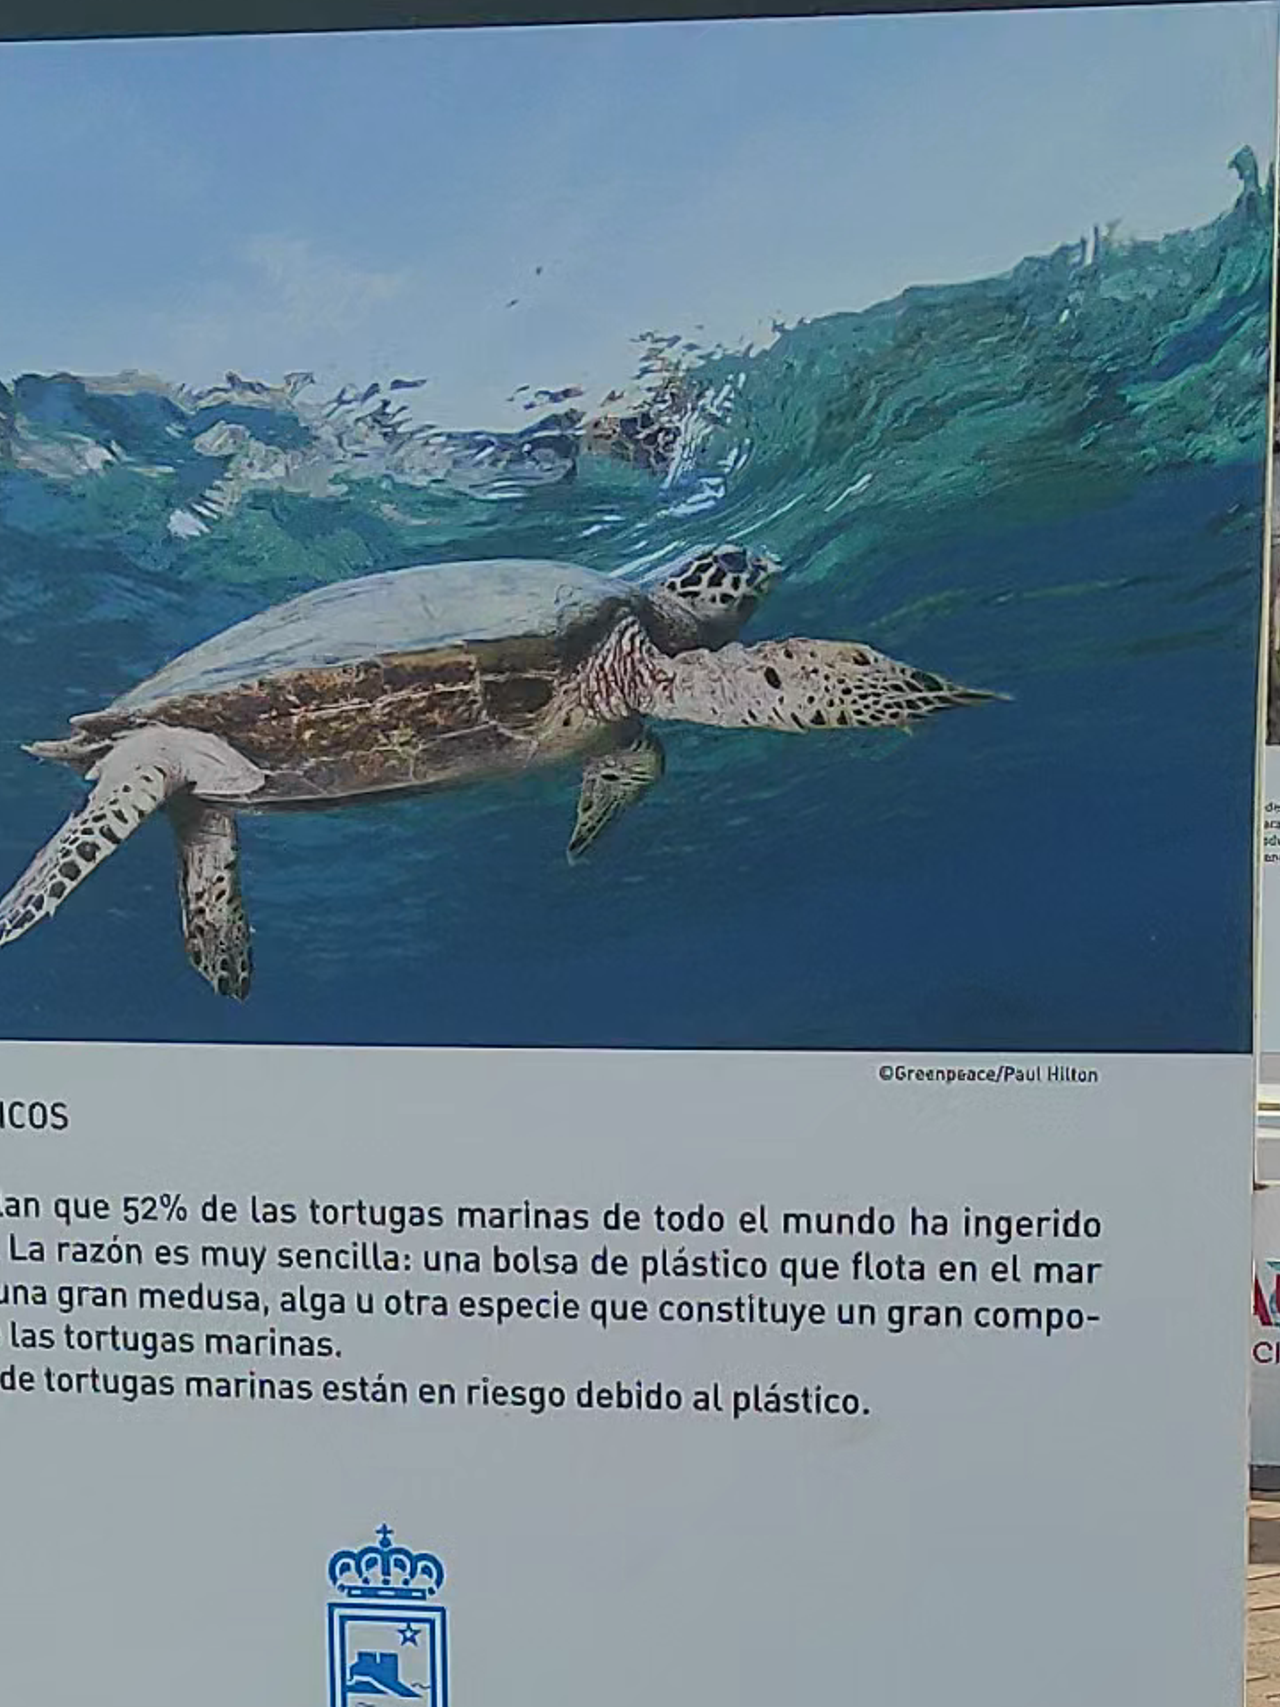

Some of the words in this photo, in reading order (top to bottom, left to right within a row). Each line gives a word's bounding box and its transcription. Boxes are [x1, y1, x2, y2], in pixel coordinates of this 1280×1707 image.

[1046, 1065, 1099, 1083] Hilton
[54, 1197, 110, 1227] que
[123, 1193, 188, 1225] 52%
[201, 1193, 238, 1224] de
[251, 1194, 297, 1225] las
[308, 1198, 444, 1235] tortugas
[457, 1199, 589, 1231] marinas
[603, 1202, 641, 1231] de
[653, 1203, 725, 1233] todo
[738, 1203, 769, 1234] el
[783, 1205, 896, 1236] mundo
[911, 1205, 948, 1236] ha
[964, 1206, 1101, 1245] ingerido
[9, 1232, 45, 1263] La
[57, 1234, 143, 1266] razón
[155, 1244, 189, 1266] es
[201, 1245, 267, 1275] muy
[277, 1240, 411, 1272] sencilla:
[423, 1250, 481, 1274] una
[493, 1244, 578, 1275] bolsa
[590, 1244, 629, 1277] de
[641, 1245, 768, 1285] plástico
[779, 1257, 840, 1288] que
[851, 1250, 925, 1282] flota
[938, 1260, 977, 1283] en
[990, 1253, 1022, 1283] el
[1033, 1262, 1103, 1285] mar
[57, 1285, 128, 1314] gran
[138, 1281, 270, 1318] medusa,
[279, 1284, 346, 1321] alga
[356, 1291, 374, 1315] u
[384, 1289, 449, 1317] otra
[459, 1289, 580, 1326] especie
[590, 1299, 649, 1330] que
[658, 1293, 826, 1332] constituye
[837, 1303, 876, 1326] un
[887, 1305, 963, 1334] gran
[973, 1306, 1101, 1338] compo-
[10, 1320, 56, 1350] las
[63, 1323, 195, 1361] tortugas
[205, 1326, 342, 1359] marinas.
[0, 1363, 36, 1392] de
[43, 1366, 175, 1403] tortugas
[185, 1370, 314, 1401] marinas
[322, 1372, 408, 1405] están
[418, 1383, 456, 1405] en
[466, 1376, 566, 1414] riesgo
[576, 1379, 683, 1411] debido
[692, 1382, 724, 1412] al
[733, 1382, 870, 1419] plástico.
